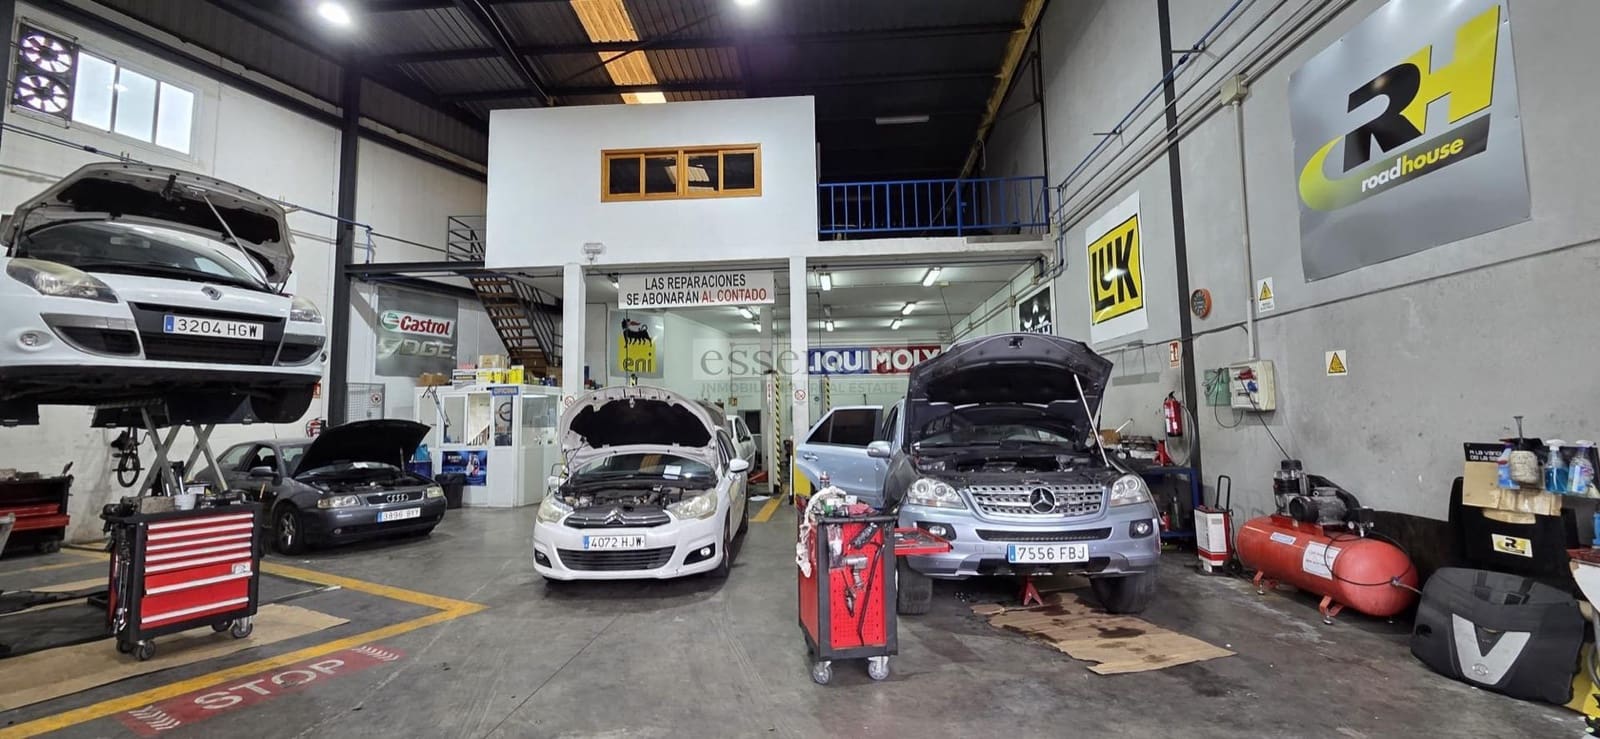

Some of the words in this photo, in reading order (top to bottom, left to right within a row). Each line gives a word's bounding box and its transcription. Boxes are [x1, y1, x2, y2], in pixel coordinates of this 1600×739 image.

[1361, 137, 1465, 192] roadhouse
[645, 278, 665, 290] LAS
[668, 273, 746, 290] REPARACIONES
[626, 293, 639, 306] SE
[702, 290, 715, 303] AL
[717, 287, 767, 302] CONTADO
[178, 318, 222, 335] 3204
[227, 323, 258, 338] HGW
[400, 315, 451, 336] Castrol
[622, 352, 652, 373] eni
[592, 537, 617, 547] 4072
[621, 536, 642, 547] HJW
[1018, 547, 1055, 560] 7556
[1060, 546, 1085, 560] FBJ
[194, 659, 345, 710] STOP
